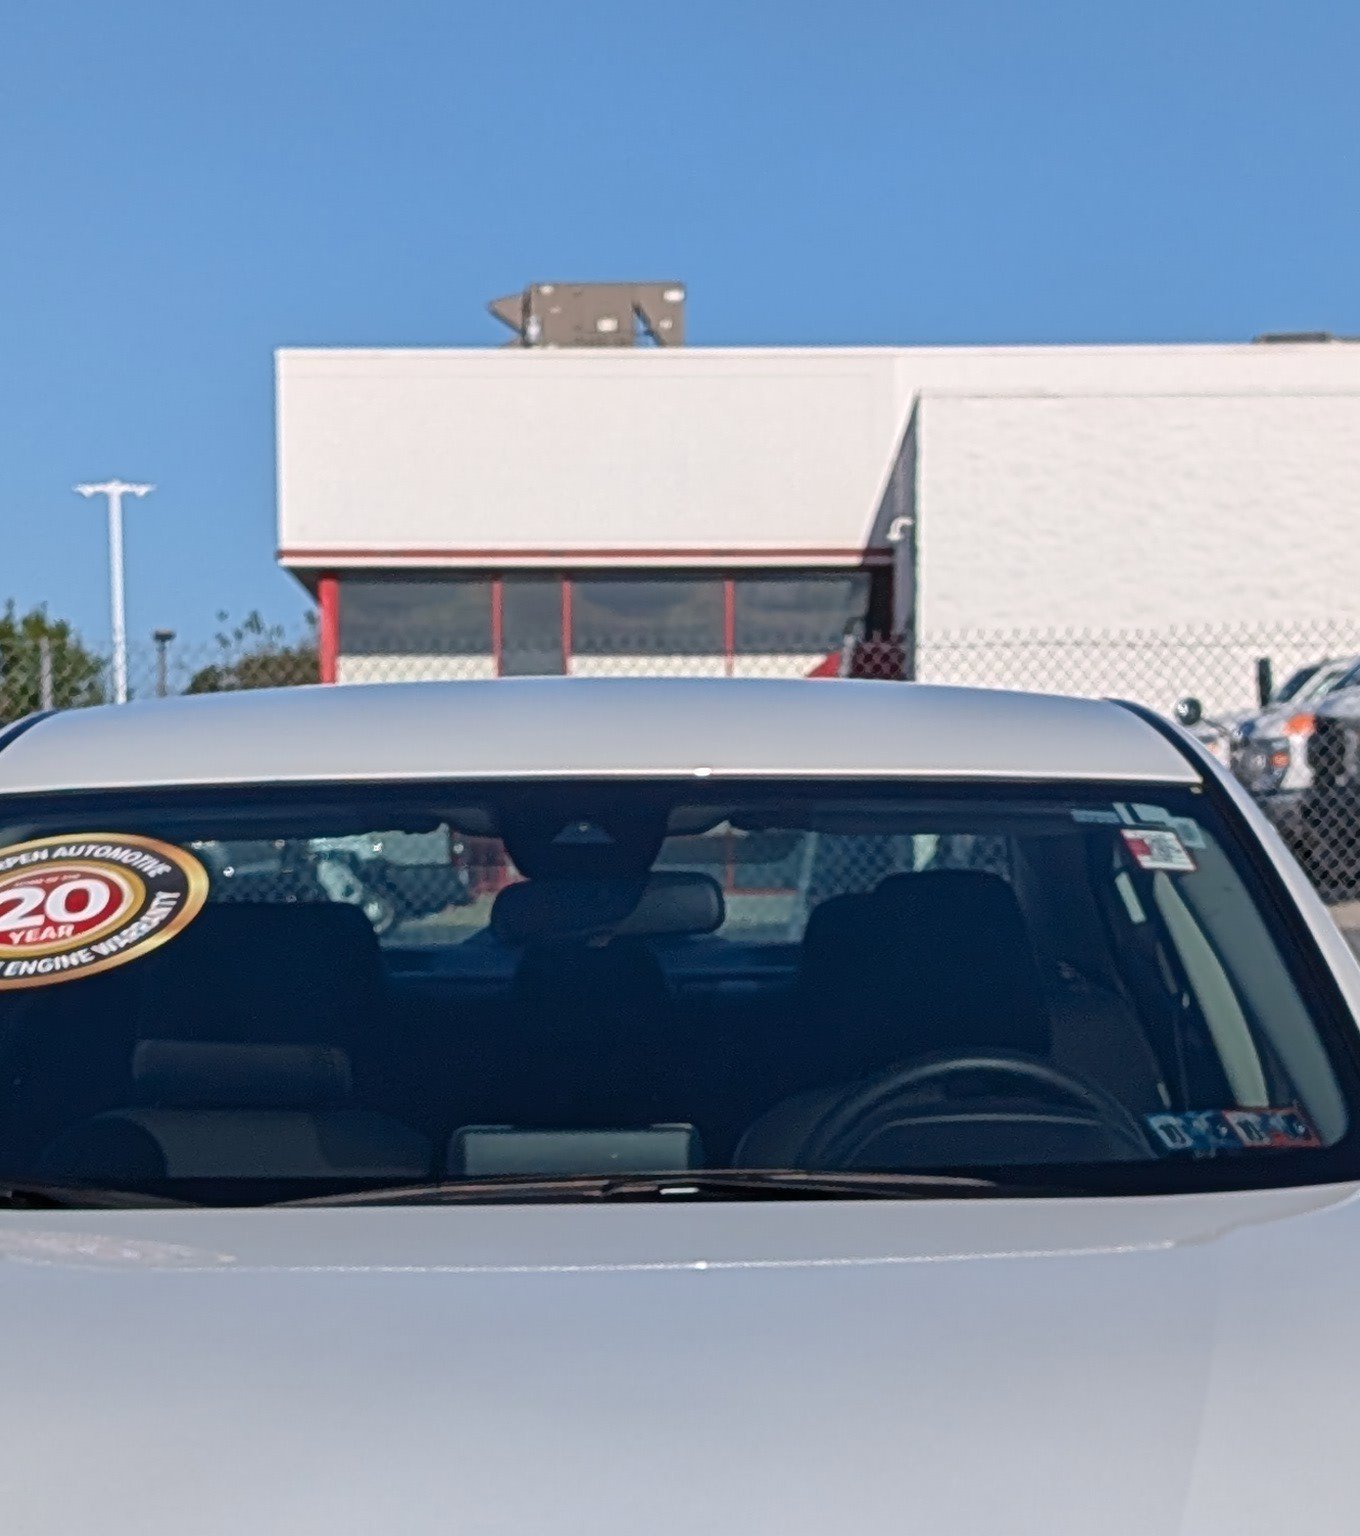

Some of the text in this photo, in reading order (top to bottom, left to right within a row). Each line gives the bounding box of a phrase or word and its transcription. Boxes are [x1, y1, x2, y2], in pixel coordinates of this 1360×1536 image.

[51, 844, 172, 878] AUTOMOTIVE
[9, 924, 75, 945] YEAR
[3, 948, 96, 977] ENGINE
